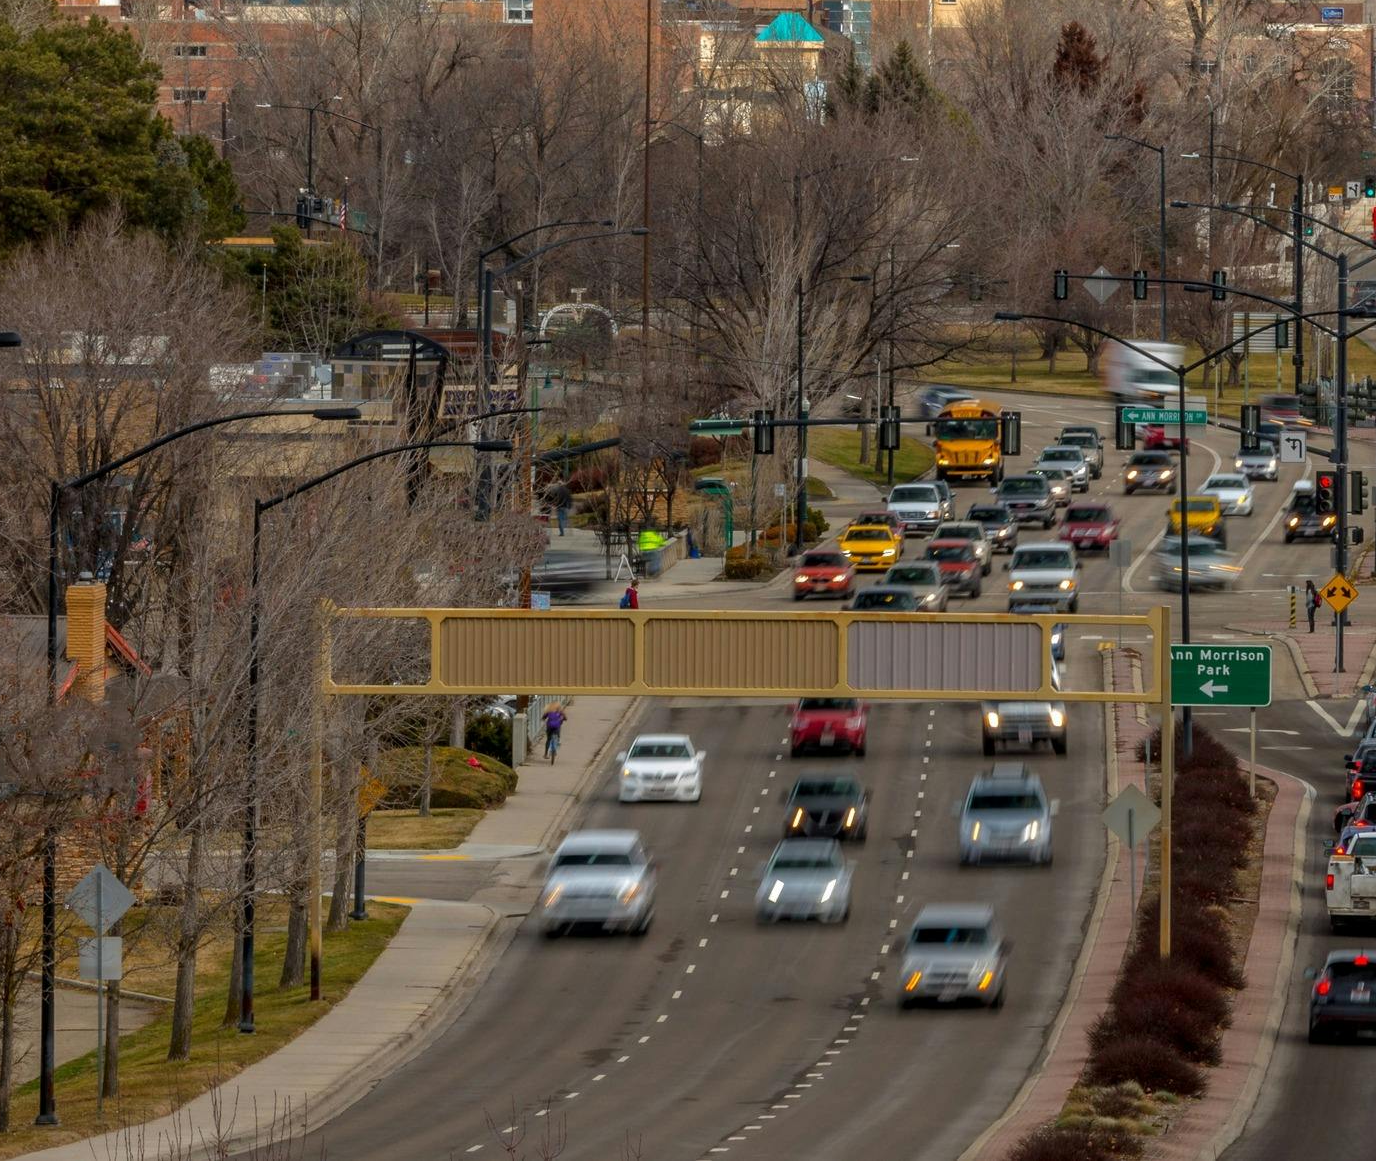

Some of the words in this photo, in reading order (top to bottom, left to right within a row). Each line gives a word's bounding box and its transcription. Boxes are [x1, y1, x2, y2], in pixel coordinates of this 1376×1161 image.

[1142, 412, 1156, 421] ANN
[1159, 412, 1193, 422] MORRION
[1200, 650, 1264, 661] Morrison
[1197, 664, 1230, 675] Park
